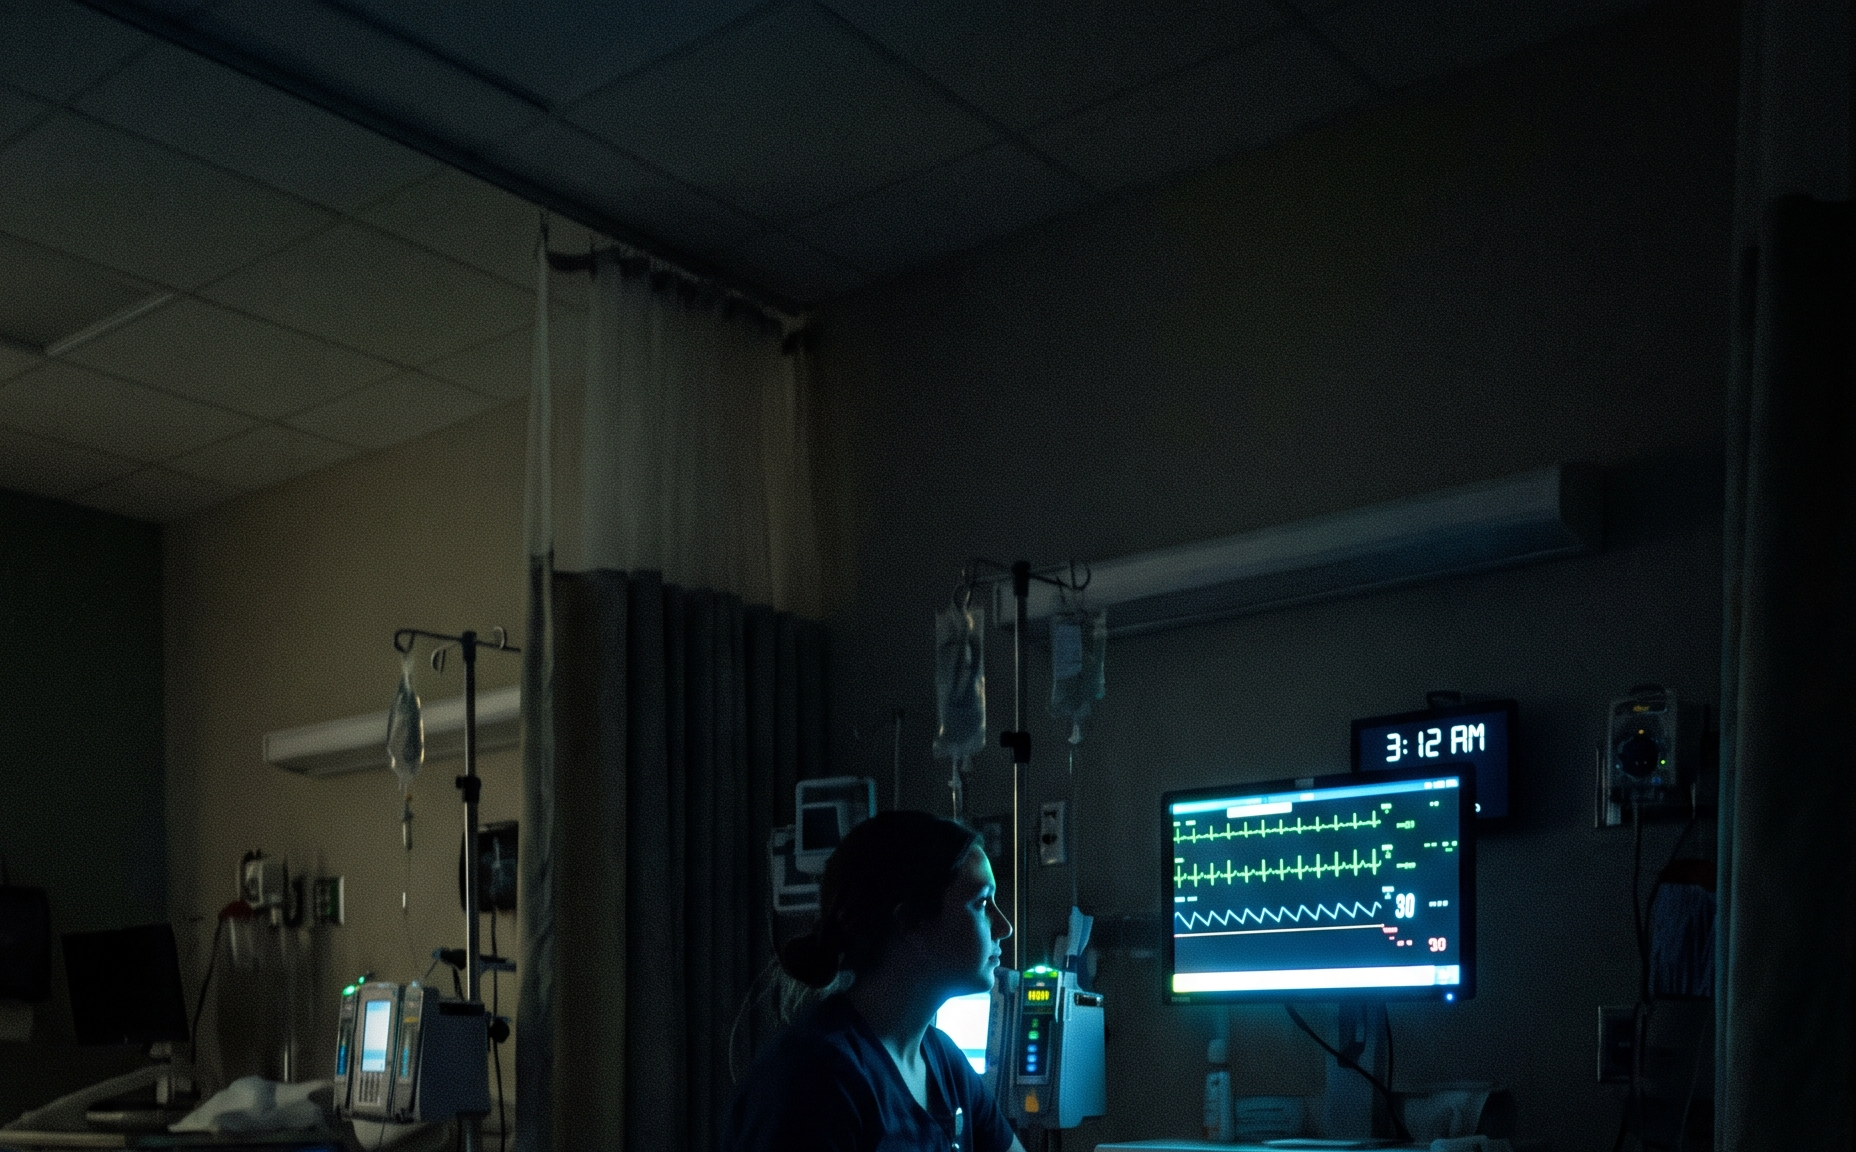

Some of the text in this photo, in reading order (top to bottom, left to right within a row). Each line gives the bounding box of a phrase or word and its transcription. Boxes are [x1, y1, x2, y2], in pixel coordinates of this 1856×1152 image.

[1386, 723, 1485, 763] 3:12 AM
[1395, 892, 1416, 920] 30
